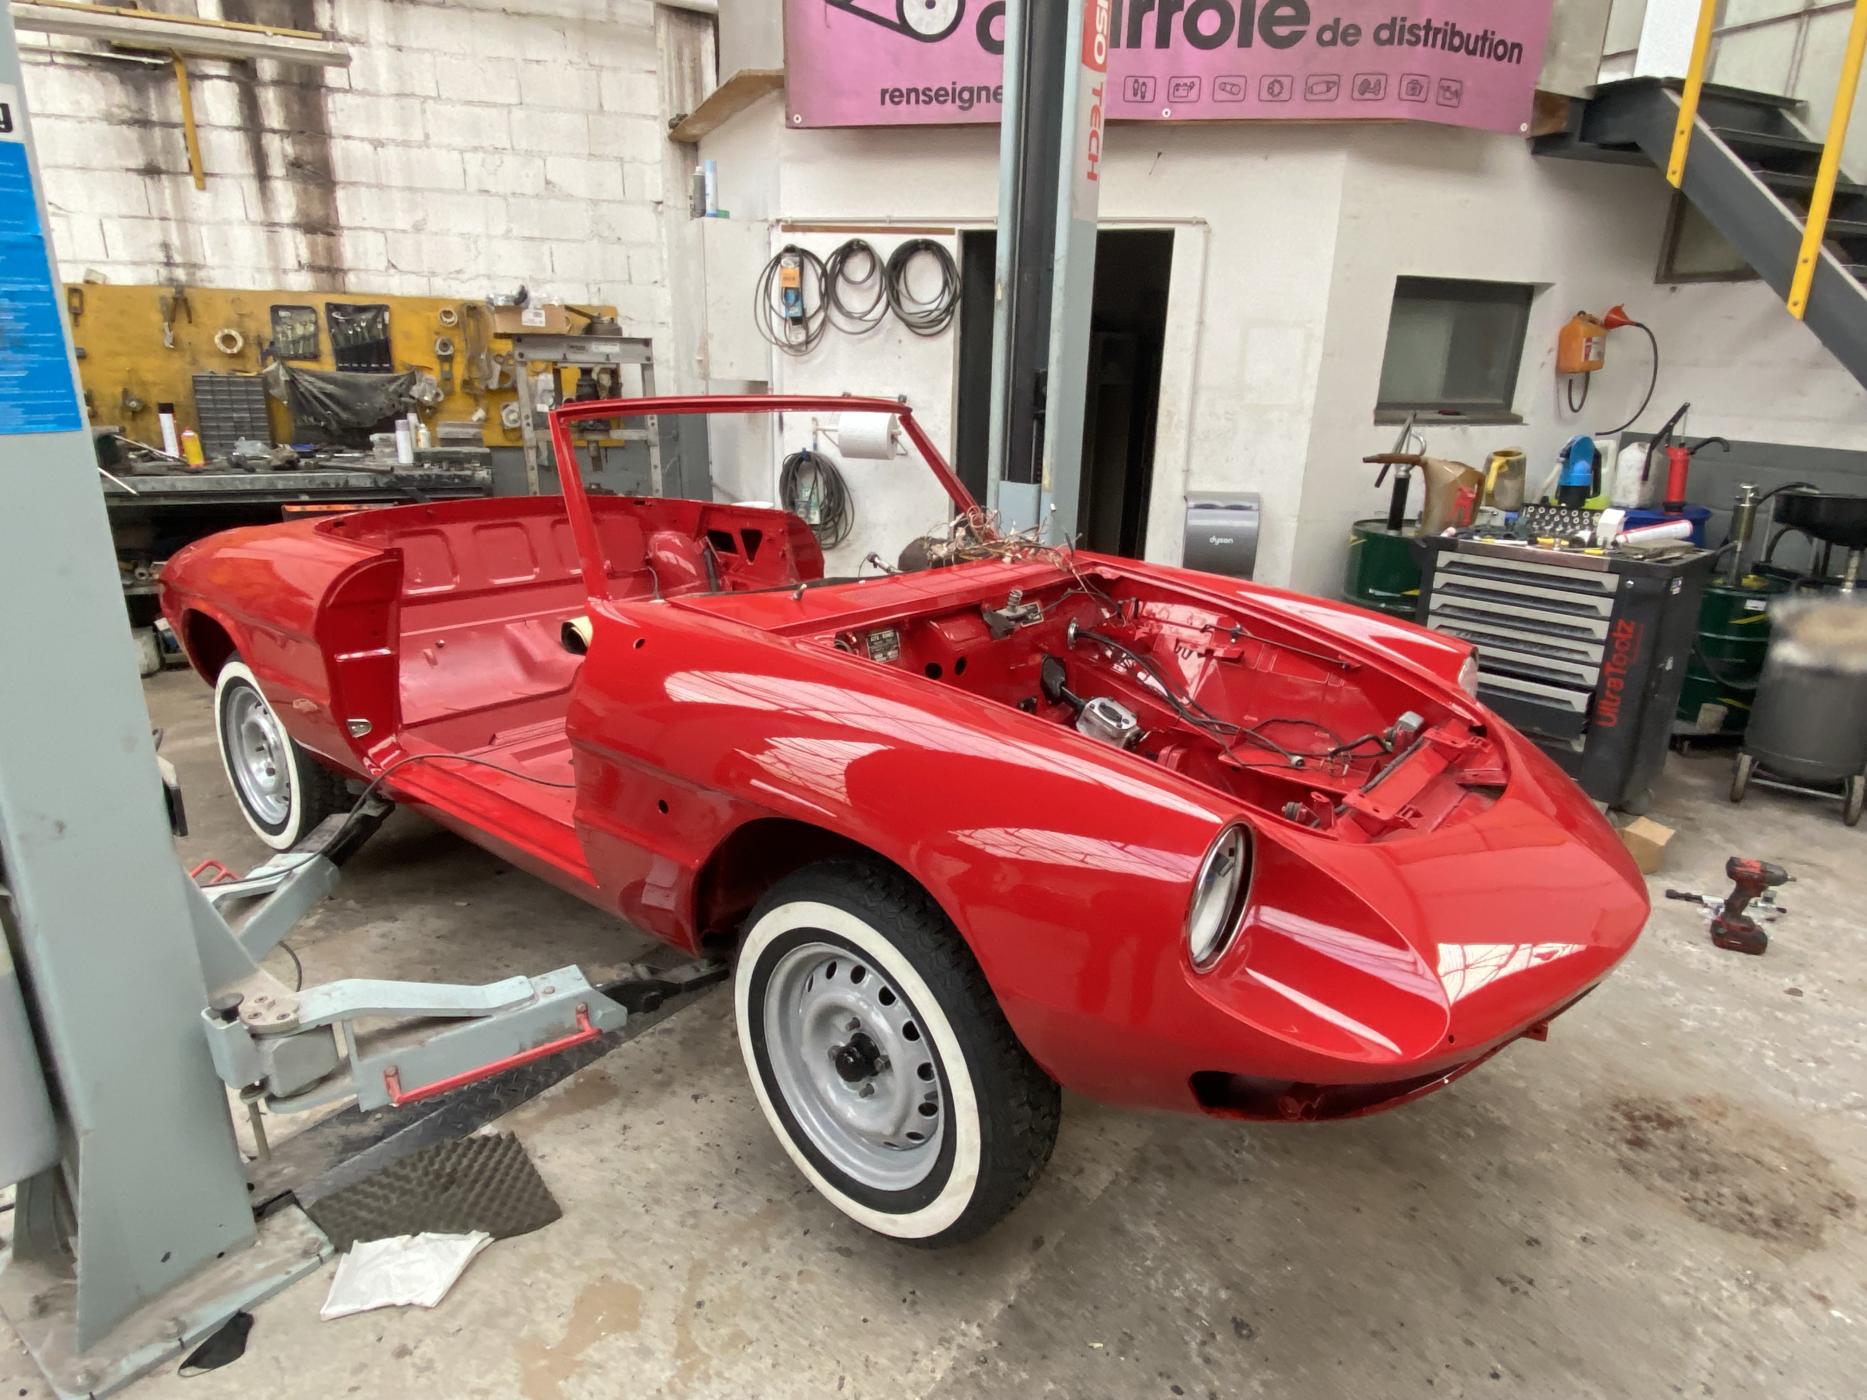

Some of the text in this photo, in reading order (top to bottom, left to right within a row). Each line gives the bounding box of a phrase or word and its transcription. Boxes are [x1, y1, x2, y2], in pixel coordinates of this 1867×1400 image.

[1316, 18, 1362, 47] de
[1373, 17, 1523, 64] distribution
[1087, 81, 1104, 181] TECH
[1209, 535, 1234, 546] dyson
